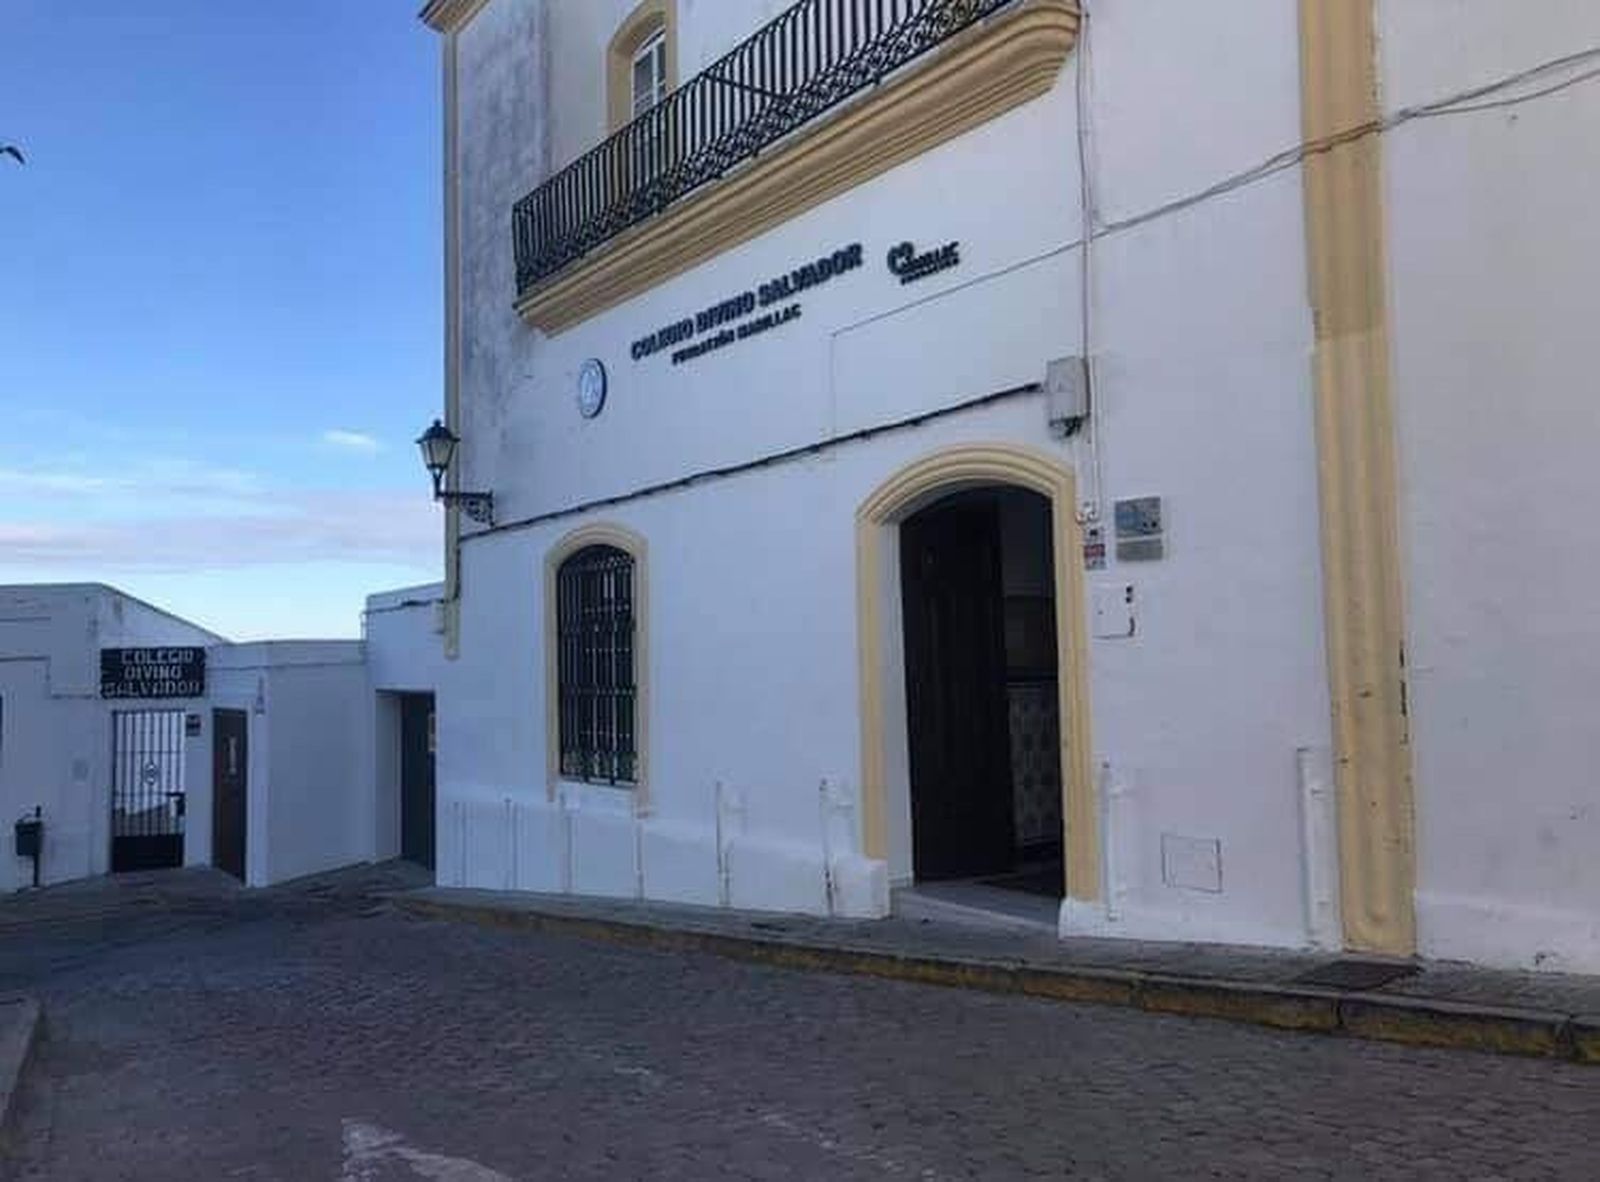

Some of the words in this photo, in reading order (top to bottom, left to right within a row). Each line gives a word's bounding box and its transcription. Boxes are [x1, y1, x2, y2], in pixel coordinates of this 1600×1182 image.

[758, 243, 863, 307] SALVADOR
[121, 650, 194, 664] COLEGIO
[124, 665, 182, 679] DIVINO
